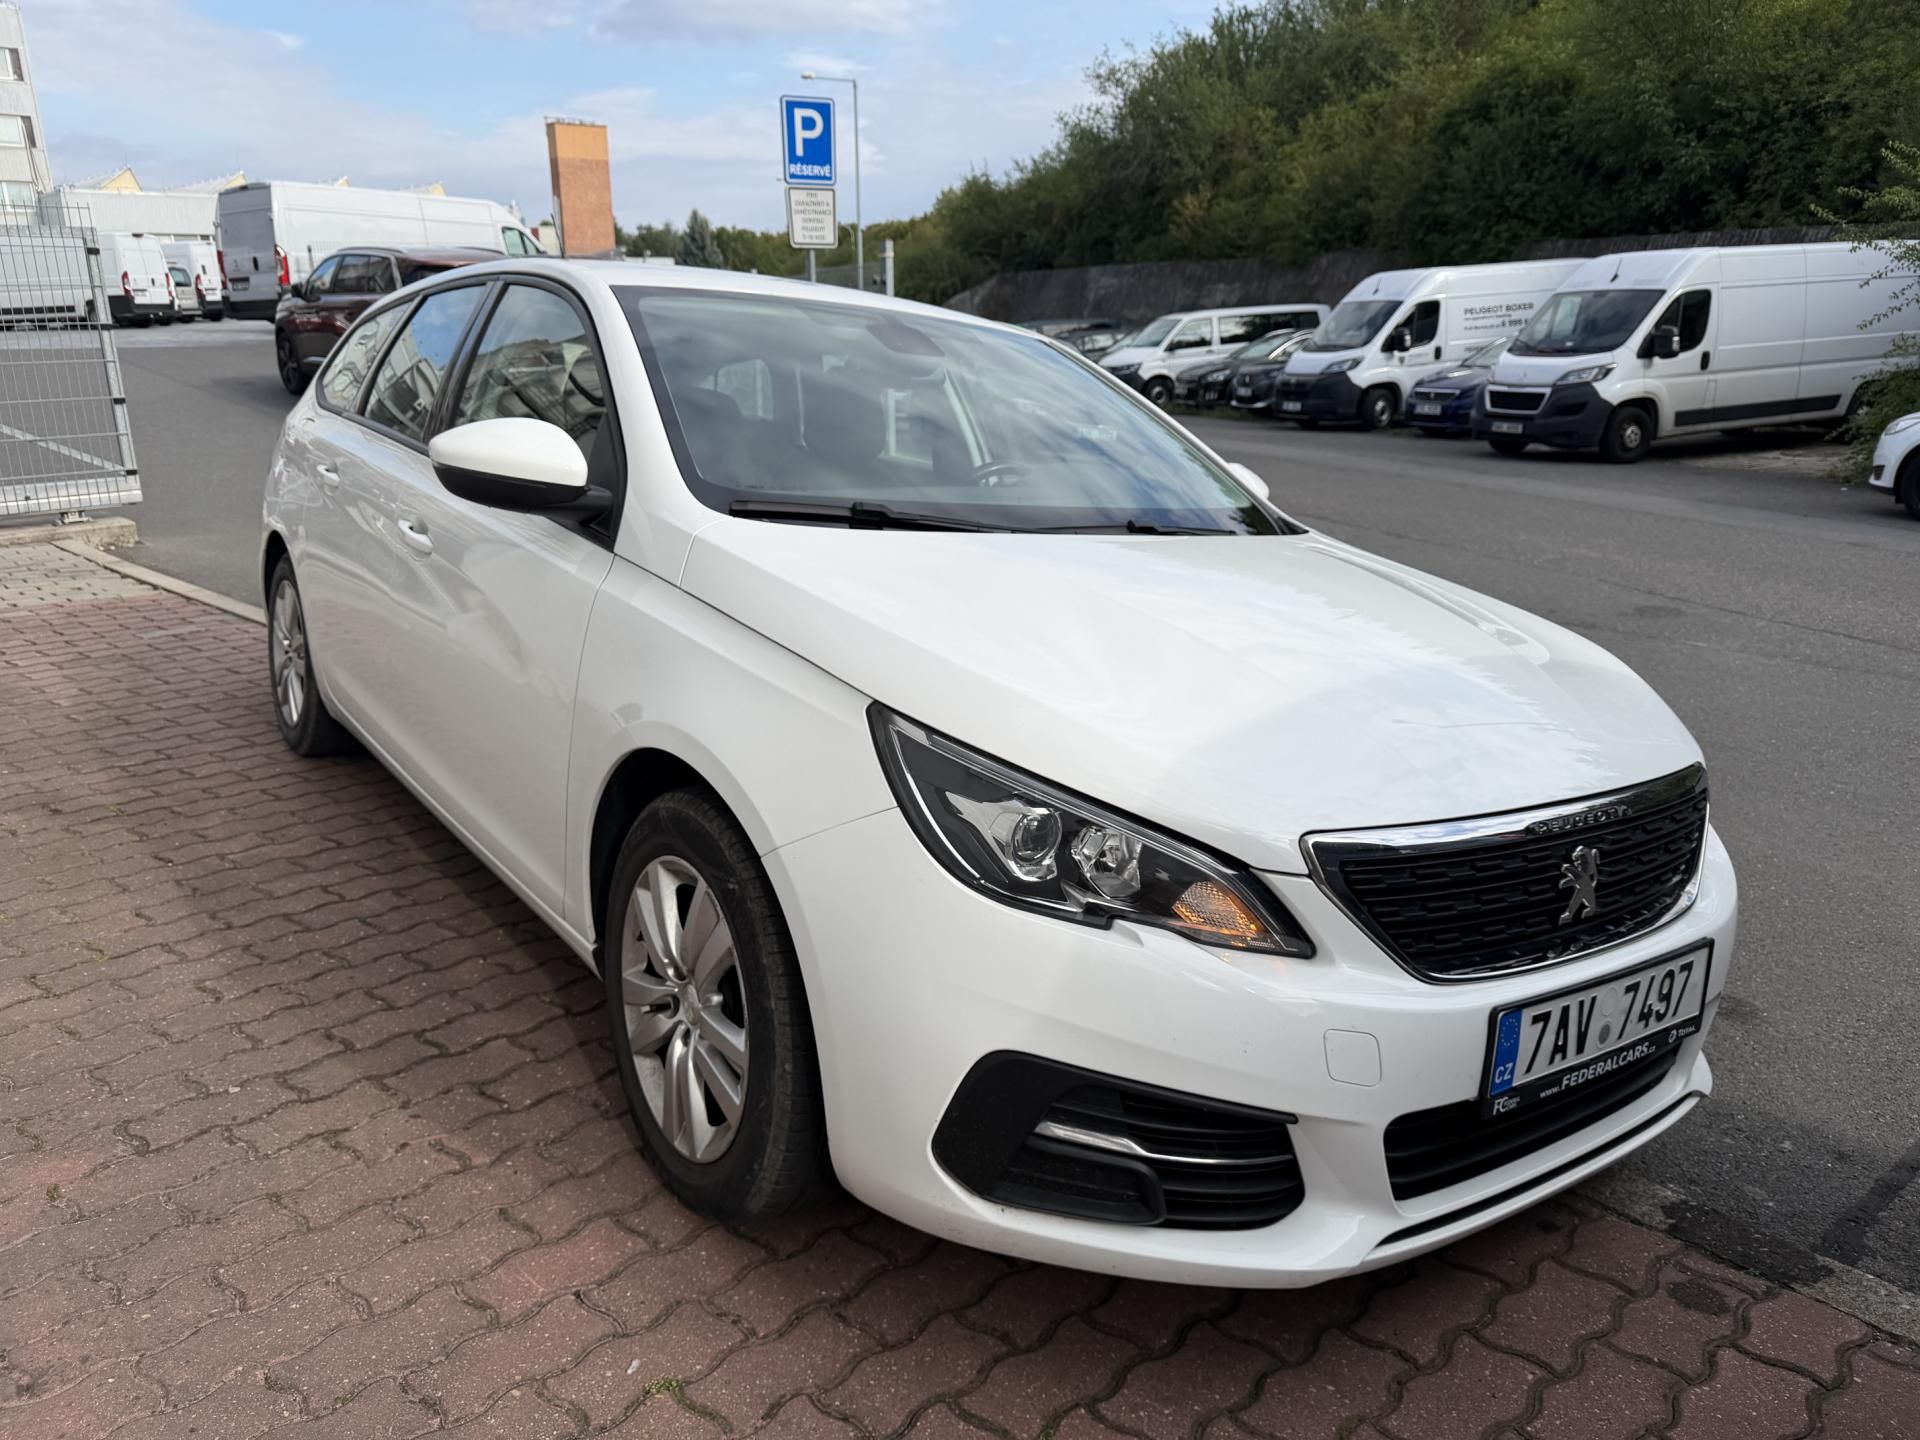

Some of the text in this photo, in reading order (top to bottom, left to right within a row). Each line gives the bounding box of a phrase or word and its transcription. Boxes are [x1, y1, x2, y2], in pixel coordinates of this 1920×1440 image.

[794, 108, 824, 157] P
[789, 163, 832, 178] RÉSERVÉ
[1463, 302, 1534, 315] PEUGEOT BOXER
[1523, 960, 1694, 1075] 7AV 7497
[1495, 1062, 1514, 1084] CZ
